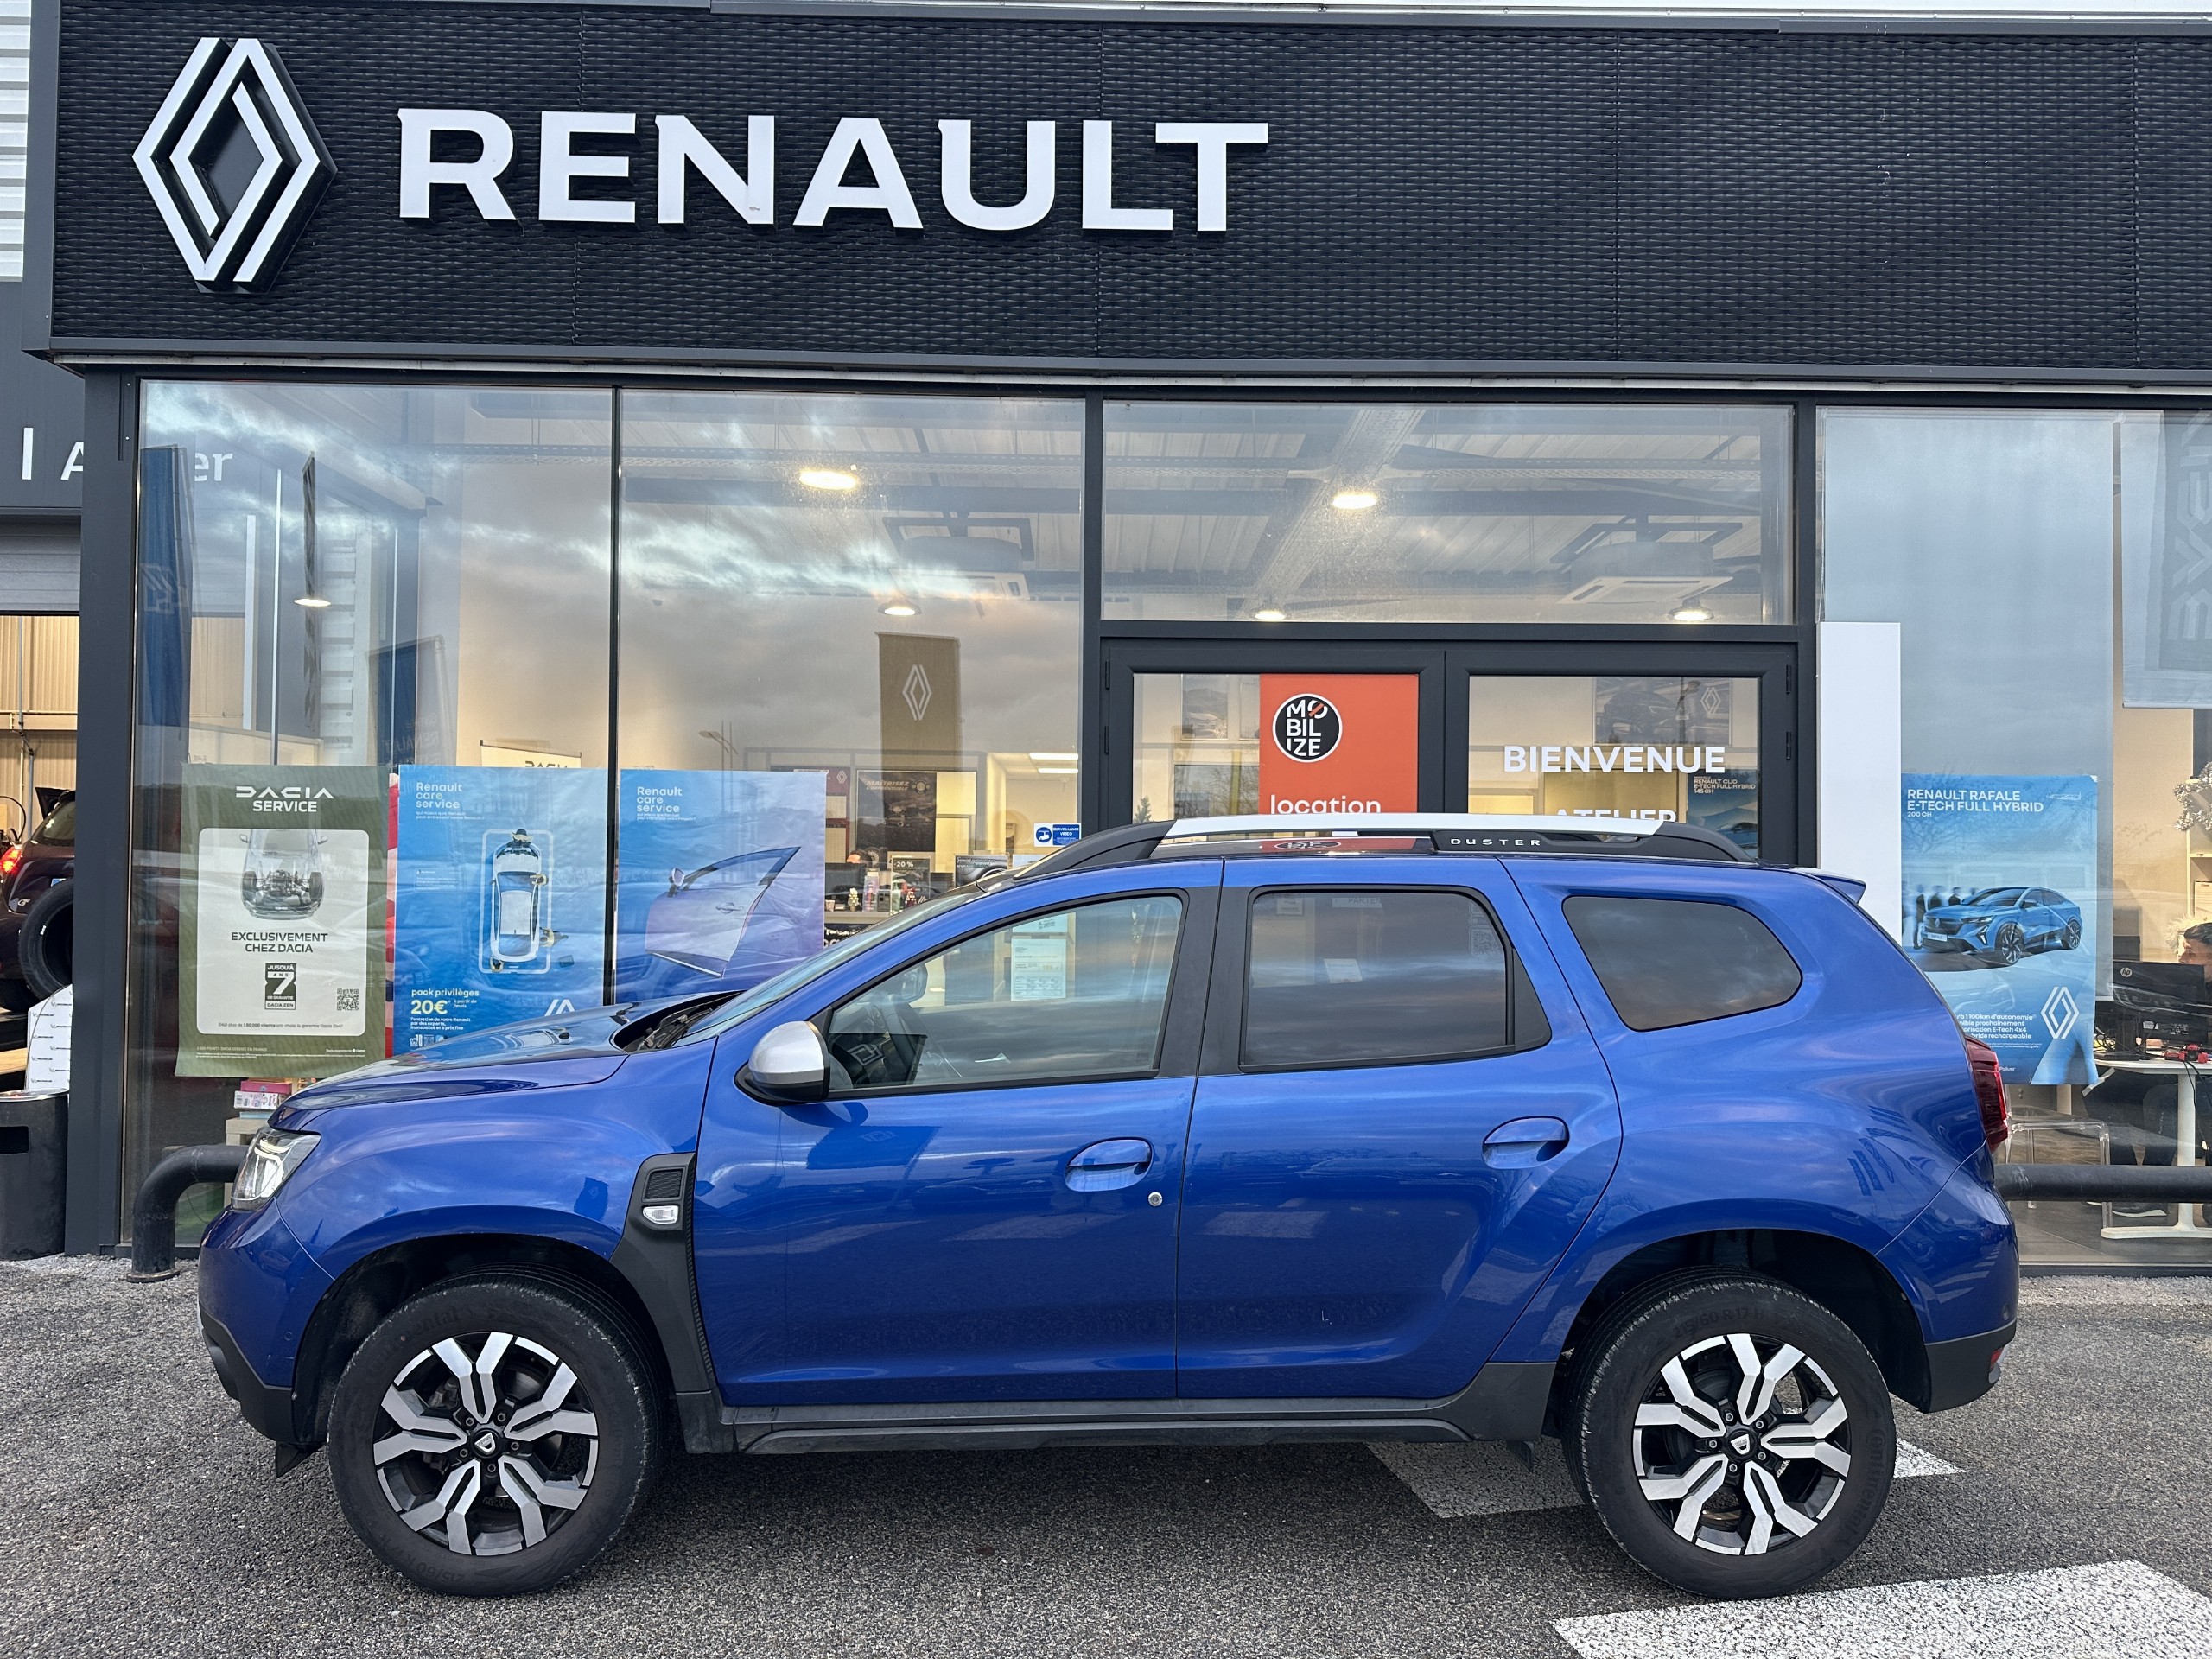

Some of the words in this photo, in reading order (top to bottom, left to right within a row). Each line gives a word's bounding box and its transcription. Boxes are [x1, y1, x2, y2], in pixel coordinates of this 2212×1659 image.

[397, 107, 1268, 232] RENAULT
[1503, 746, 1726, 774] BIENVENUE
[235, 785, 334, 799] DACIA
[416, 782, 463, 792] Renault
[637, 786, 683, 796] Renault
[1907, 789, 1967, 800] RENAULT
[1969, 791, 2020, 800] RAFALE
[252, 800, 317, 812] SERVICE
[416, 799, 461, 809] service
[636, 804, 680, 812] service
[1270, 794, 1381, 814] location
[1907, 800, 1955, 810] E-TECH
[1956, 801, 1990, 811] FULL
[1993, 802, 2044, 812] HYBRID
[231, 931, 328, 942] EXCLUSIVEMENT
[245, 944, 276, 952] CHEZ
[278, 944, 314, 953] DACIA
[2121, 968, 2132, 977] hp
[268, 971, 294, 995] 7
[411, 988, 434, 997] pack
[435, 988, 480, 998] privilèges
